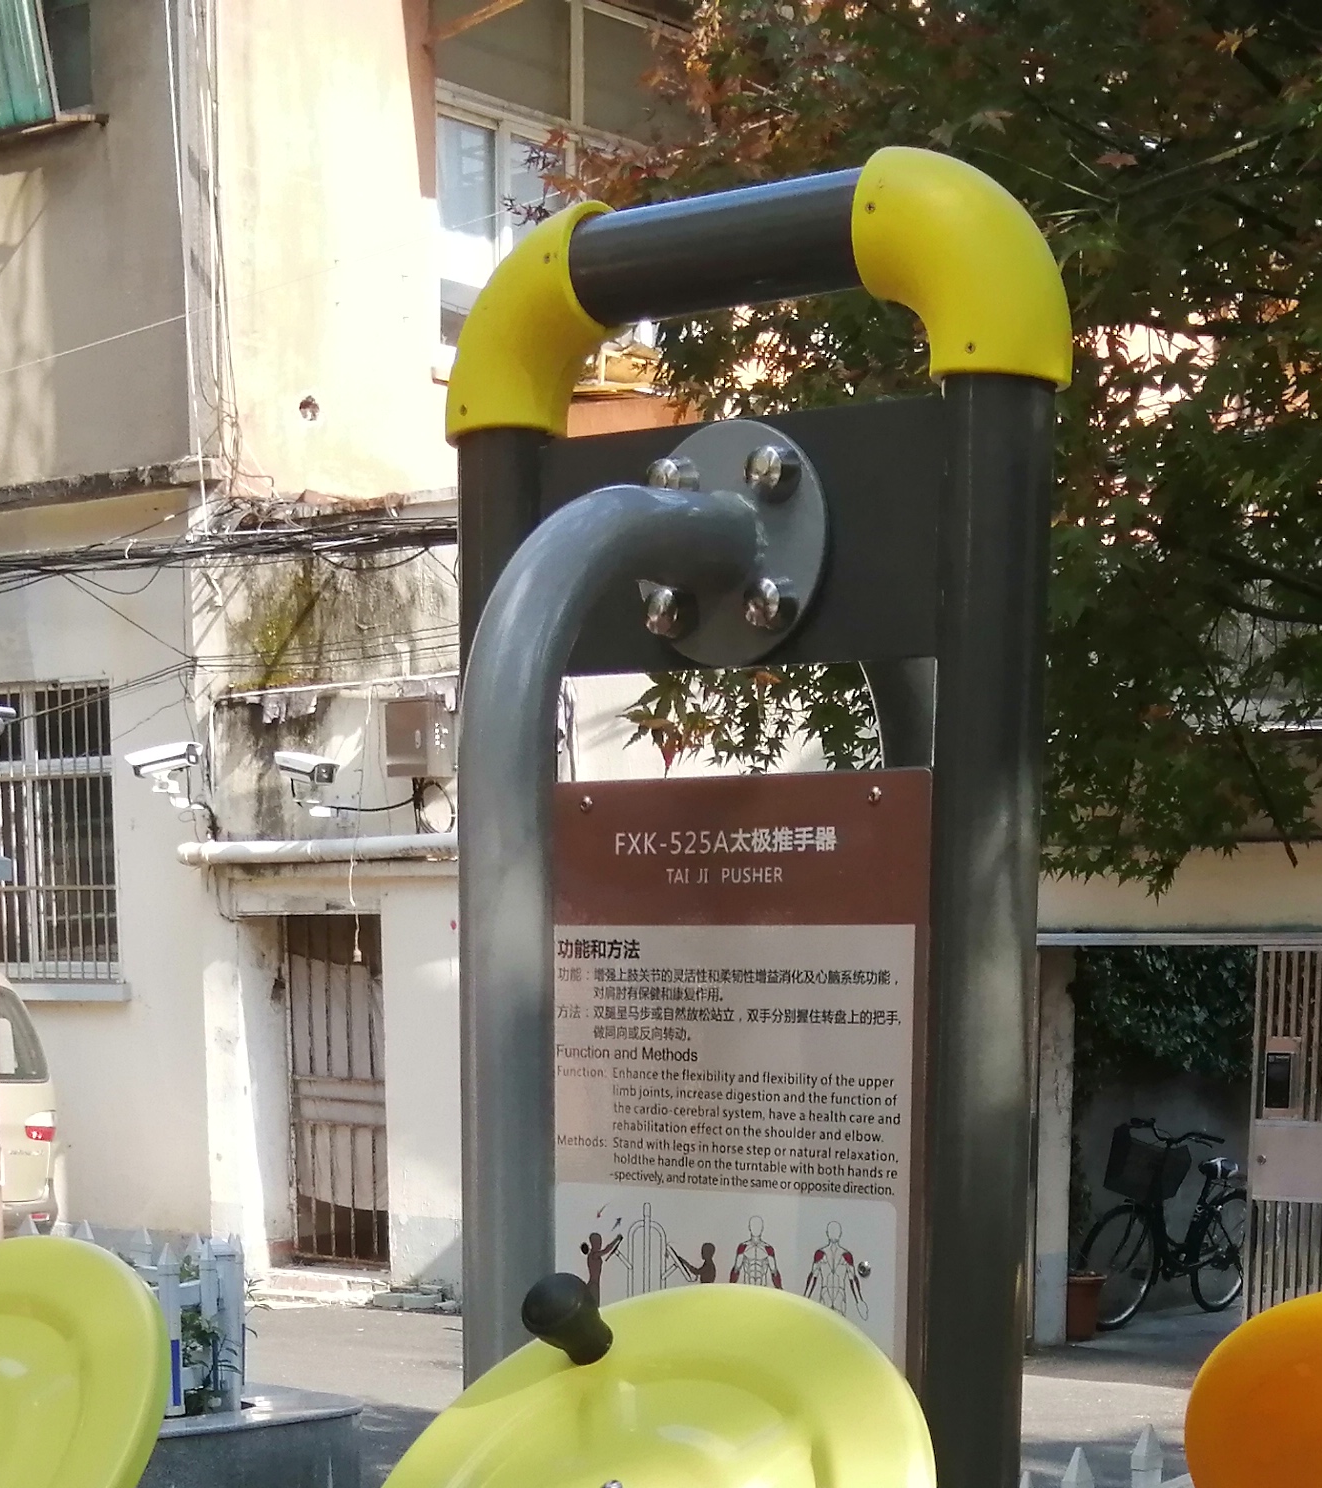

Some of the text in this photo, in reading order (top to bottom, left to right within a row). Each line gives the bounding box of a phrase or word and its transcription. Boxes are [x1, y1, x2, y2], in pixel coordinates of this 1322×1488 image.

[615, 827, 837, 855] FXK-525A太极推手器
[666, 867, 783, 884] TAI JI PUSHER
[557, 939, 641, 960] 功能和方法
[556, 1044, 699, 1062] Function and Methods
[557, 1065, 895, 1091] Function: Enhance the flexibility and flexibility of the upper
[613, 1085, 898, 1107] limb joints, increase digestion and the function of
[614, 1102, 901, 1126] the cardio-cerebral system, have a health care and
[613, 1120, 884, 1143] rehabilitation effect on the shoulder and elbow.
[557, 1134, 608, 1148] Methods:
[613, 1137, 644, 1150] Stand
[647, 1138, 670, 1151] with
[673, 1140, 696, 1155] legs
[699, 1141, 709, 1153] in
[712, 1142, 743, 1155] horse
[746, 1145, 771, 1159] step
[774, 1148, 787, 1158] or
[789, 1146, 832, 1159] natural
[614, 1153, 898, 1180] holdthe handle on the turntable with both hands re
[666, 1173, 686, 1184] and
[687, 1173, 718, 1186] rotate
[719, 1174, 730, 1186] in
[731, 1175, 749, 1187] the
[750, 1178, 778, 1190] same
[780, 1180, 792, 1190] or
[793, 1180, 841, 1194] opposite
[843, 1181, 895, 1196] direction.
